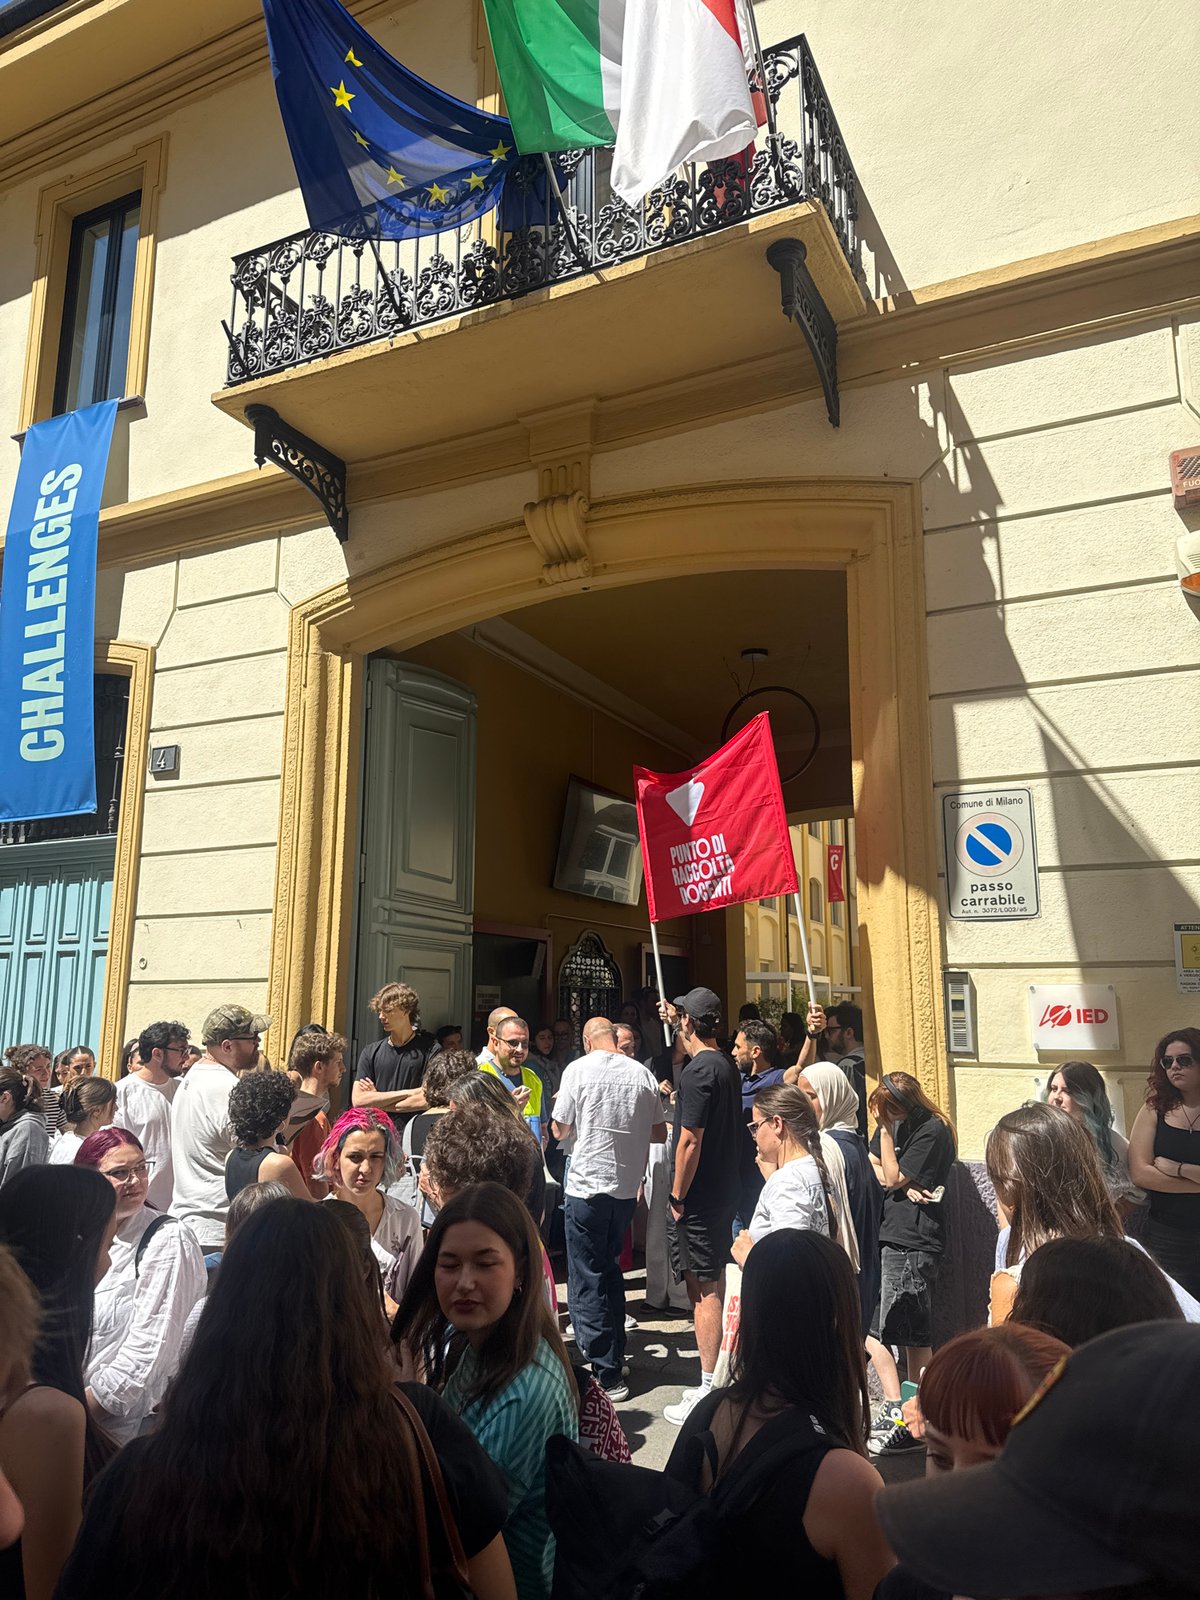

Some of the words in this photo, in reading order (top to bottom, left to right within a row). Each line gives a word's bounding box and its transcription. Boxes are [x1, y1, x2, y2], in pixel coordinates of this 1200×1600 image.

[19, 463, 83, 762] CHALLENGES
[156, 749, 166, 769] 4
[950, 800, 983, 810] Comune
[986, 798, 994, 807] di
[996, 797, 1023, 806] Milano
[669, 837, 711, 866] PUNTO
[711, 832, 727, 855] DI
[671, 853, 735, 886] RACCOLTA
[679, 875, 732, 905] DOCENTI
[970, 882, 1013, 894] passo
[960, 894, 1026, 907] carrabile
[1076, 1008, 1109, 1024] IED
